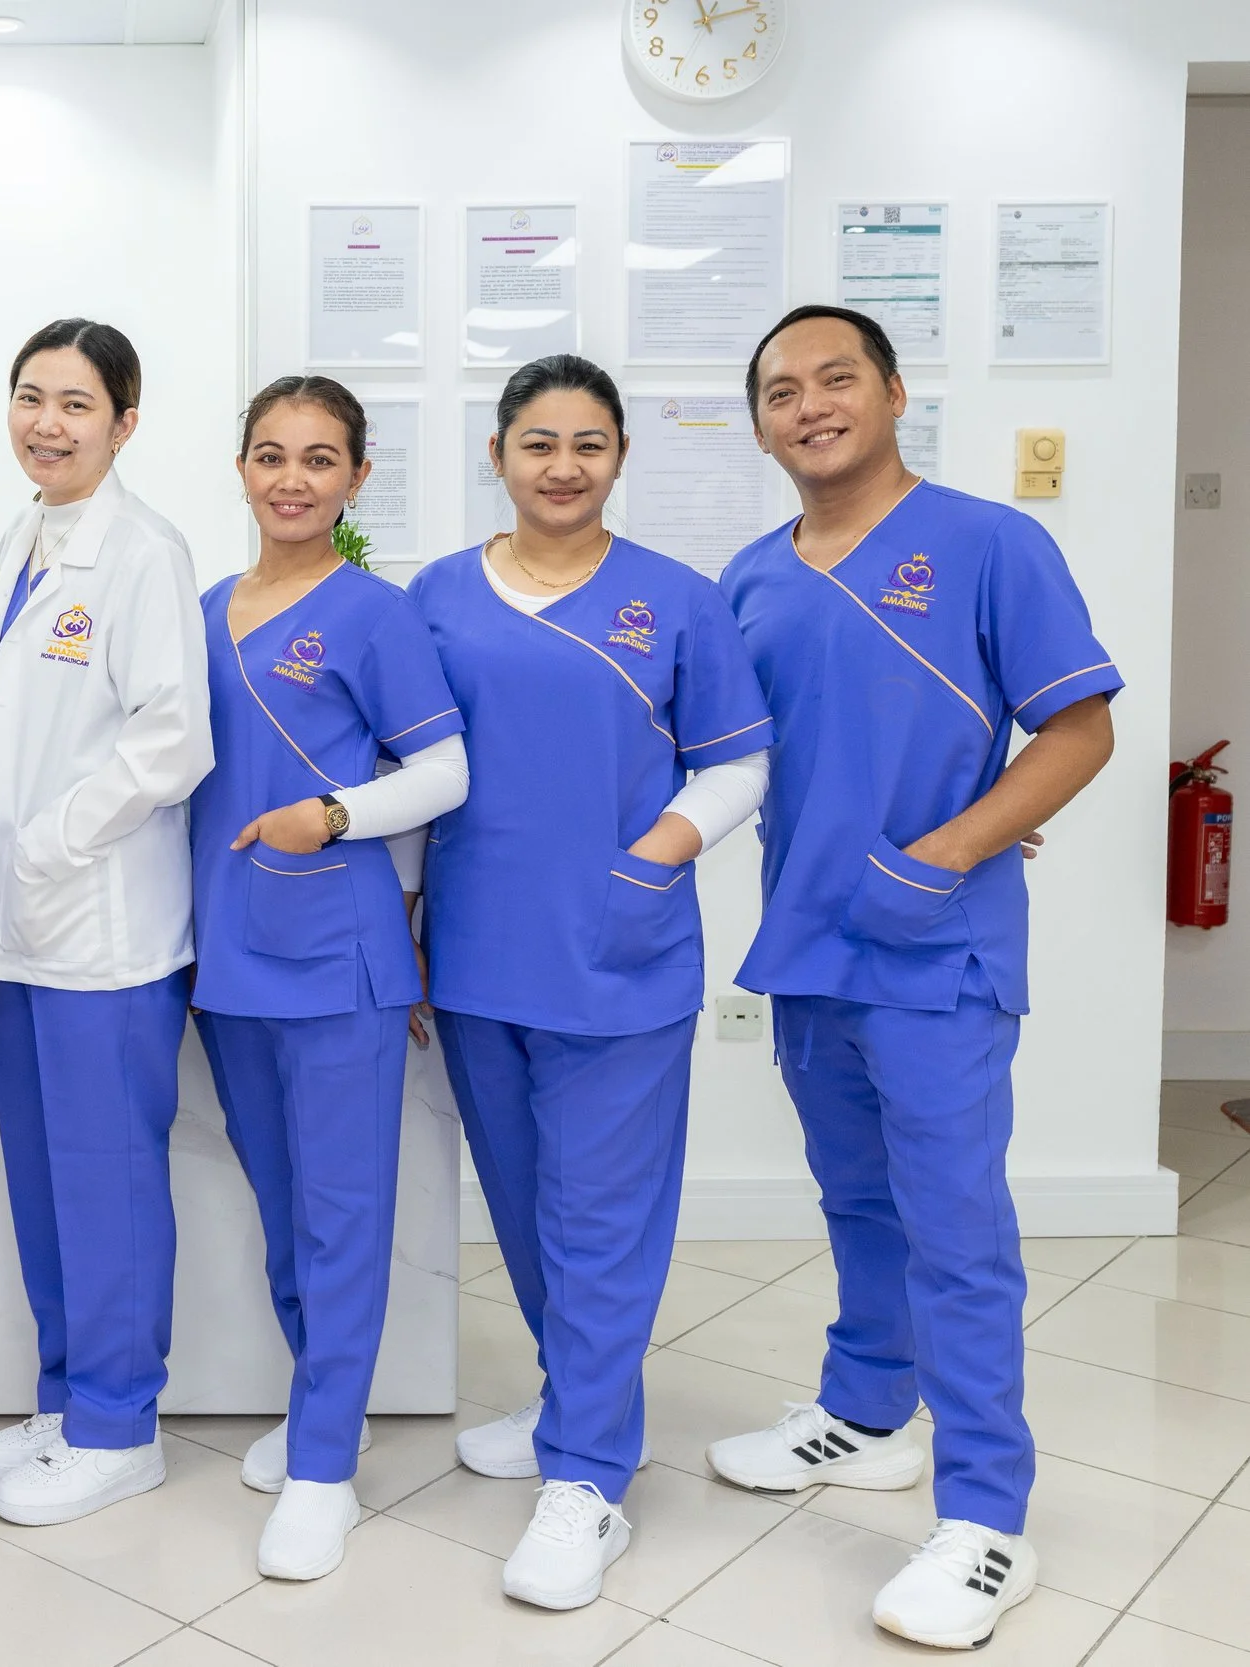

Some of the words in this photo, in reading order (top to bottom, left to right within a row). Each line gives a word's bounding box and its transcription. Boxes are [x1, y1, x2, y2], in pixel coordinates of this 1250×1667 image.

[644, 8, 659, 28] 9
[754, 13, 768, 33] 3
[649, 36, 664, 57] 8
[742, 39, 758, 60] 4
[669, 56, 684, 78] 7
[695, 65, 710, 86] 6
[723, 58, 738, 80] 5
[881, 595, 927, 610] AMAZING
[48, 646, 87, 659] AMAZING
[608, 635, 650, 652] AMAZING
[273, 665, 314, 684] AMAZING
